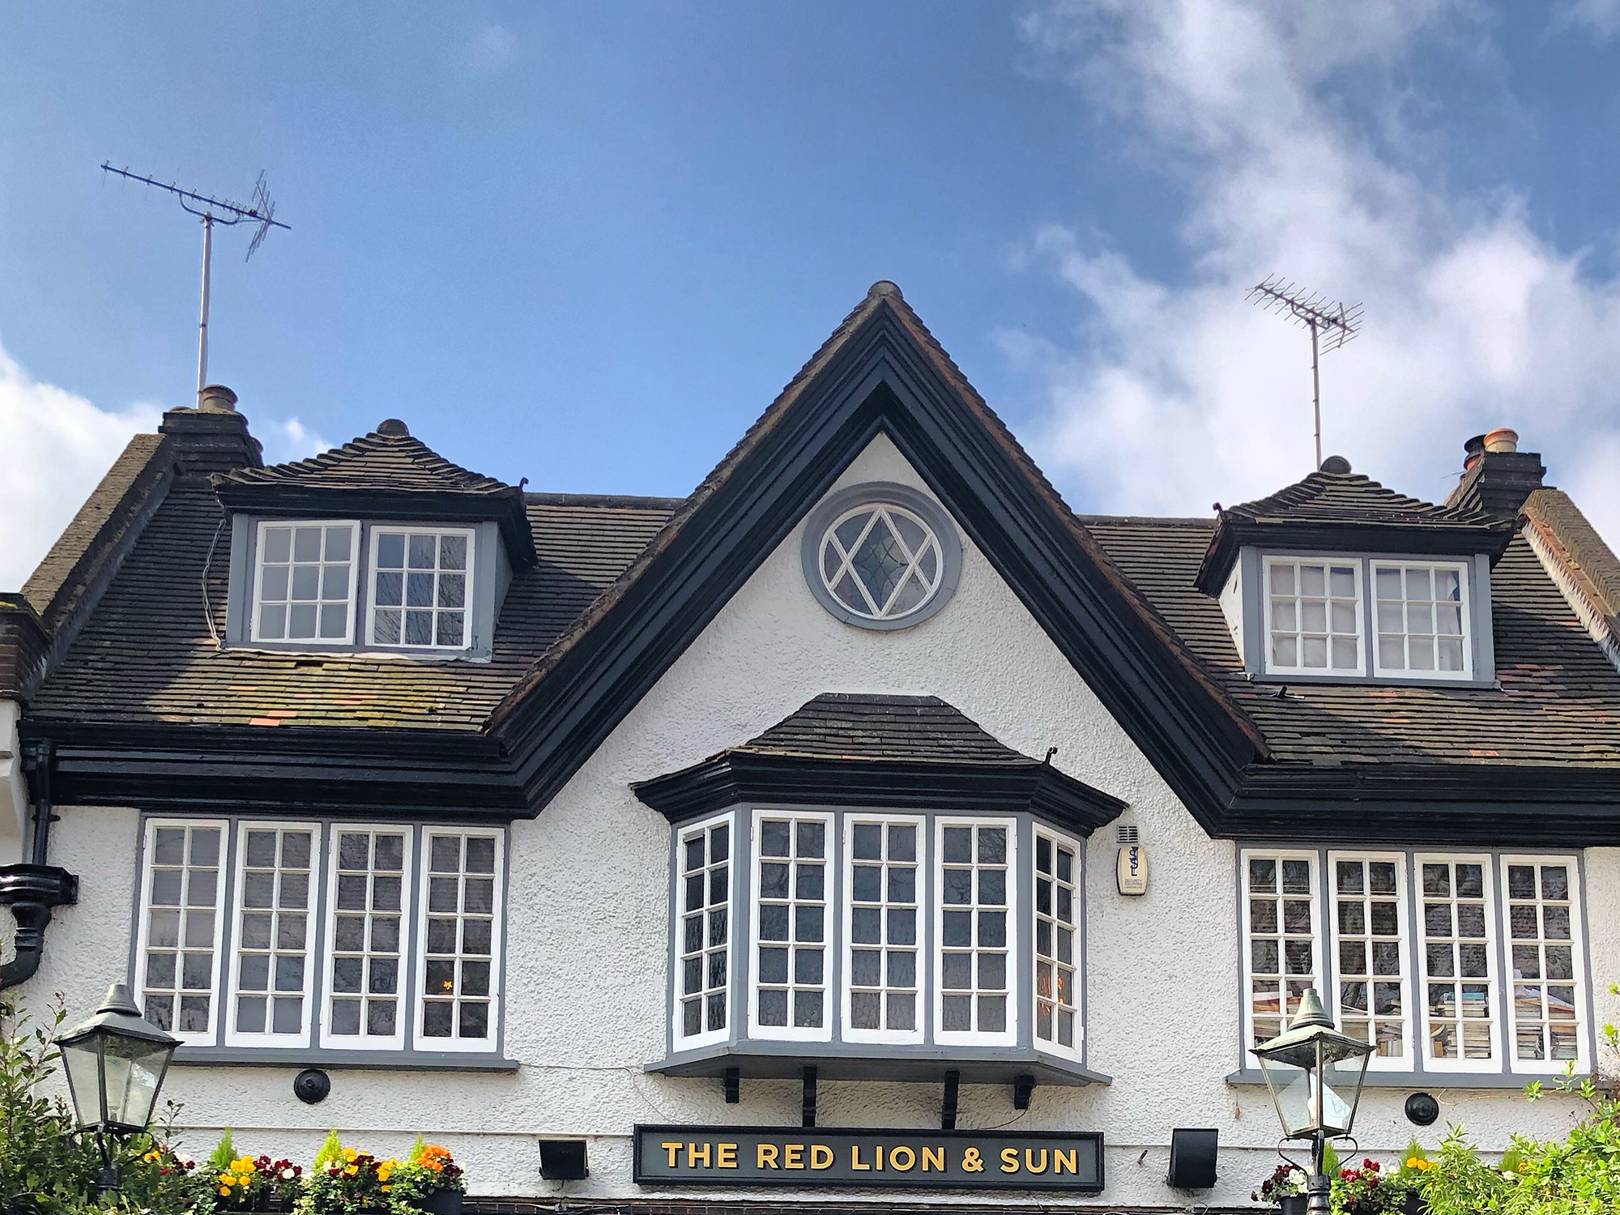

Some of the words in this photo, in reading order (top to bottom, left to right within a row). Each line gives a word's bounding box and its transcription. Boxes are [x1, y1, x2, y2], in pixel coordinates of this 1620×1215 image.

[660, 1141, 738, 1169] THE
[756, 1143, 835, 1170] RED
[850, 1145, 945, 1172] LION
[961, 1146, 984, 1173] &
[1000, 1147, 1079, 1175] SUN
